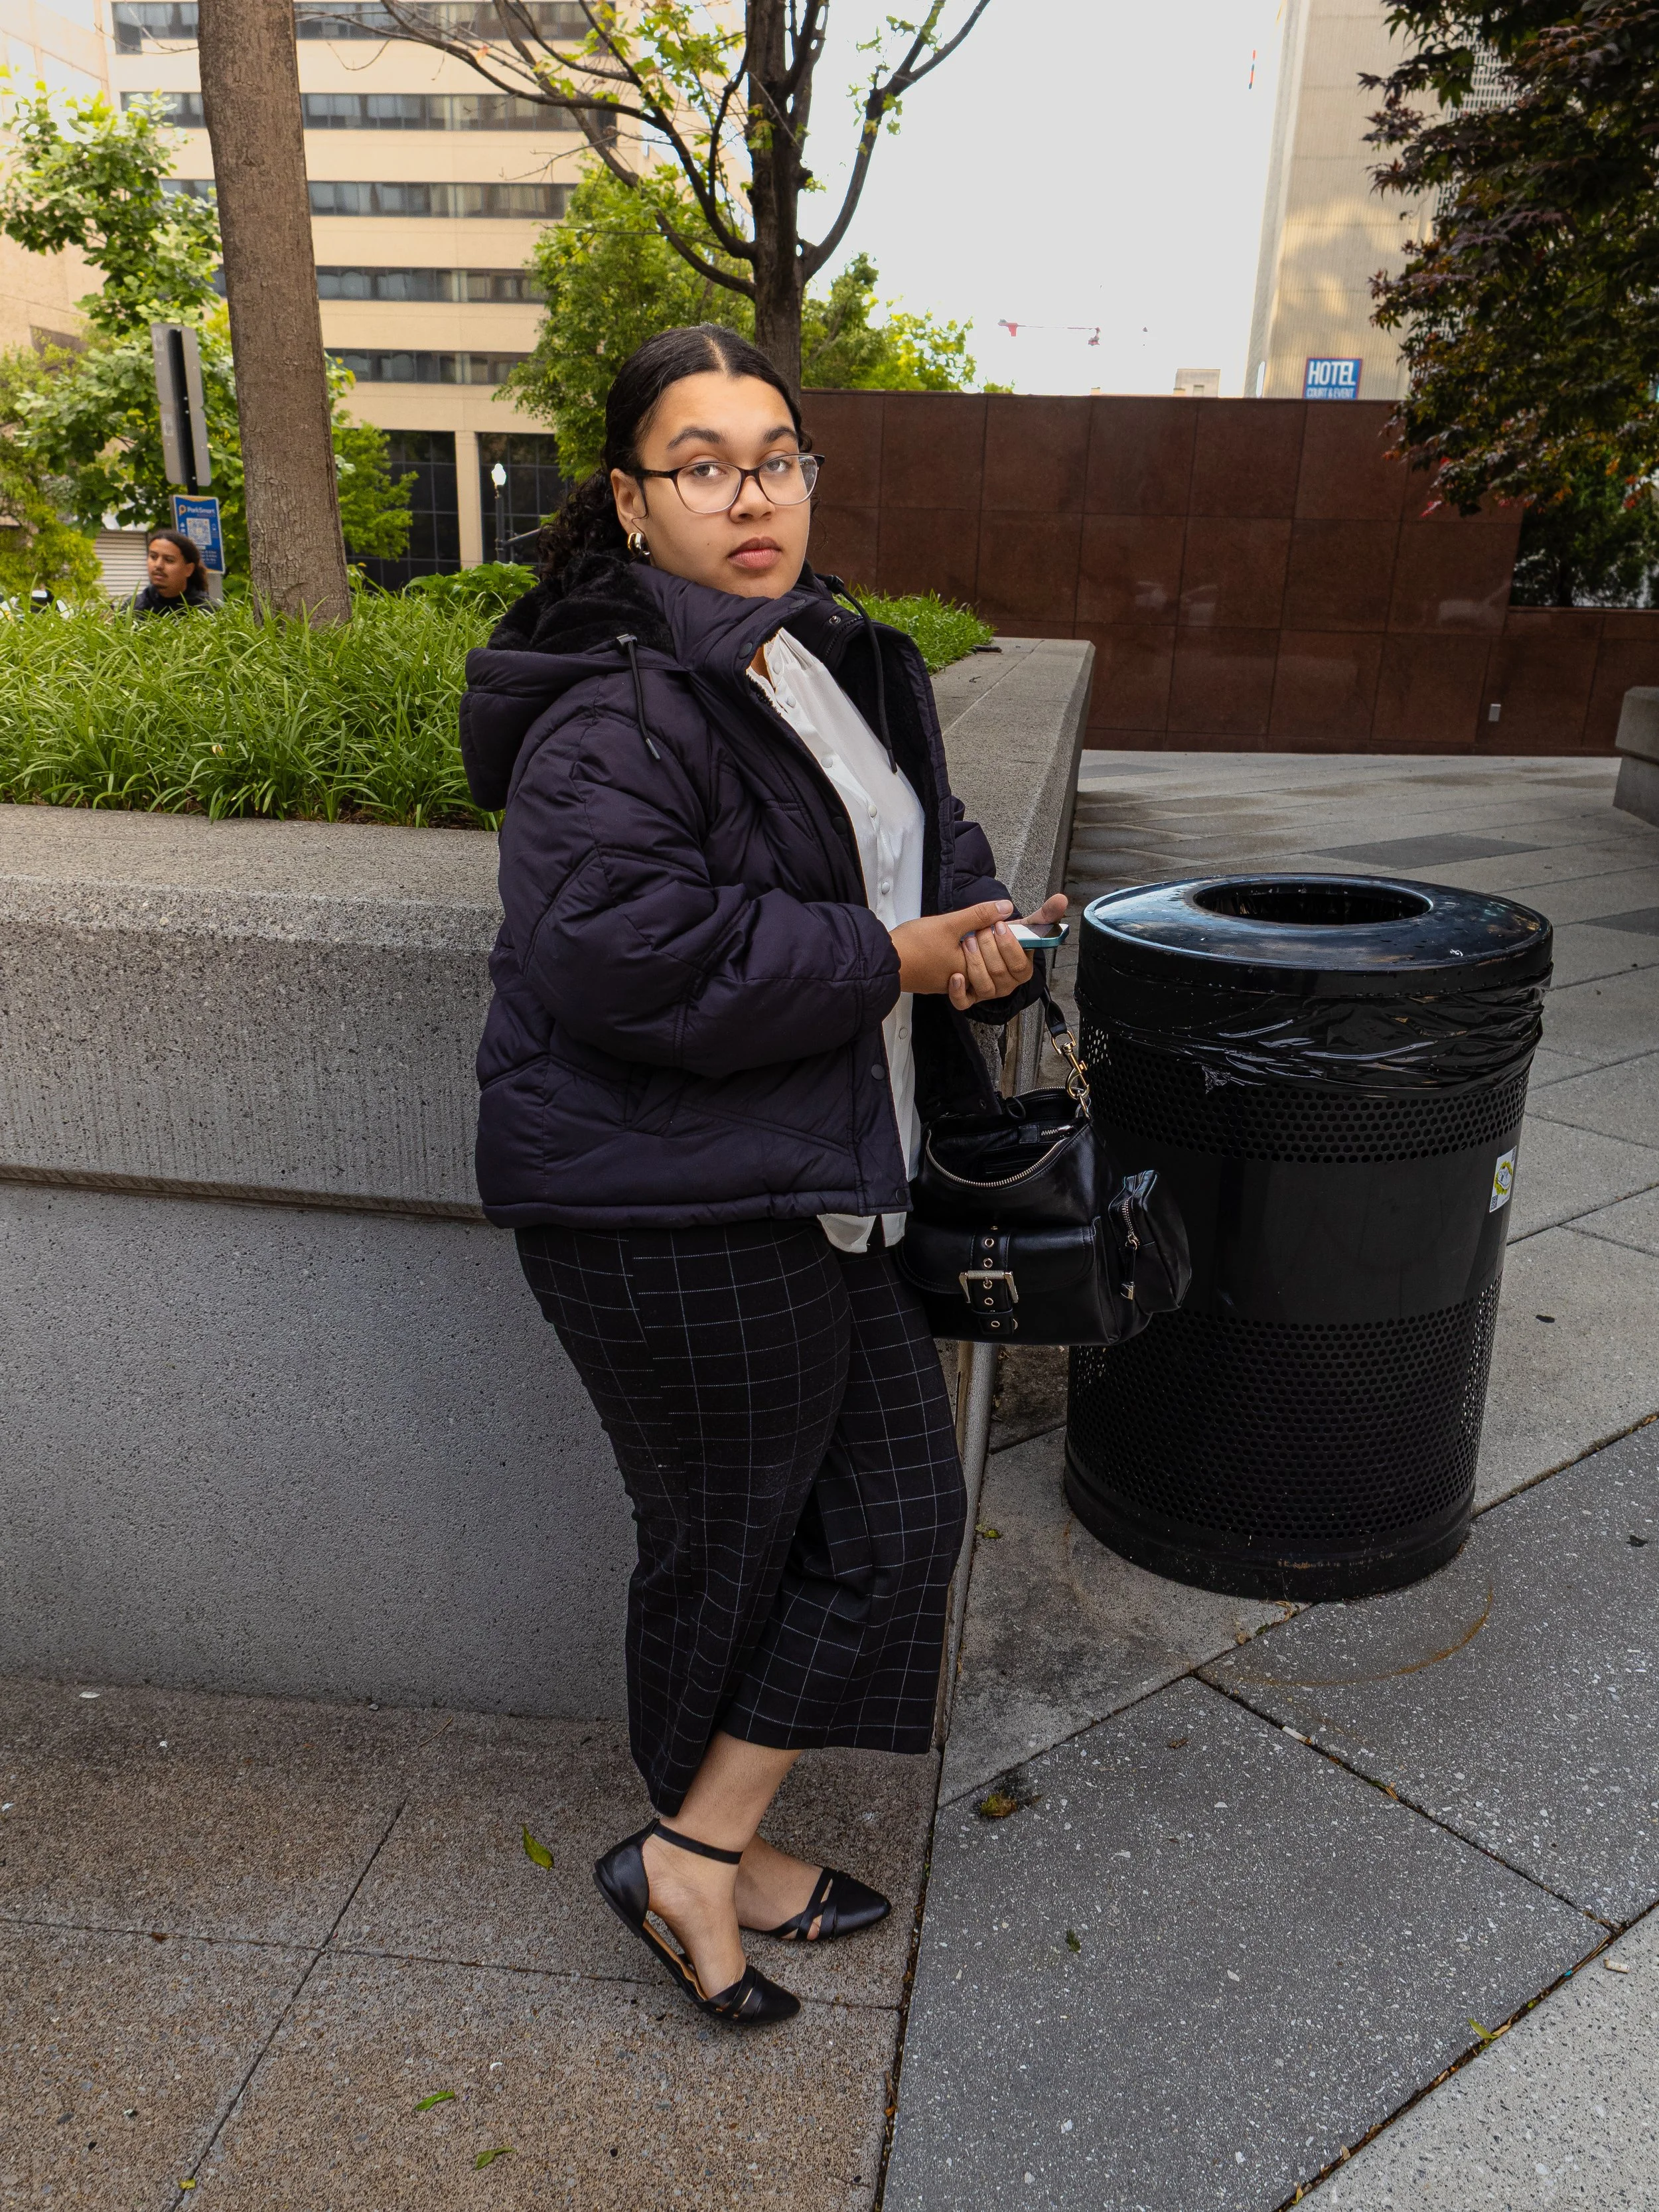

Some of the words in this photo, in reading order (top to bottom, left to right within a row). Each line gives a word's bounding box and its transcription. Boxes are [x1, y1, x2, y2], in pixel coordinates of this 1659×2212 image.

[1307, 361, 1356, 386] HOTEL
[1306, 388, 1327, 398] COURT
[1333, 388, 1354, 399] EVENT
